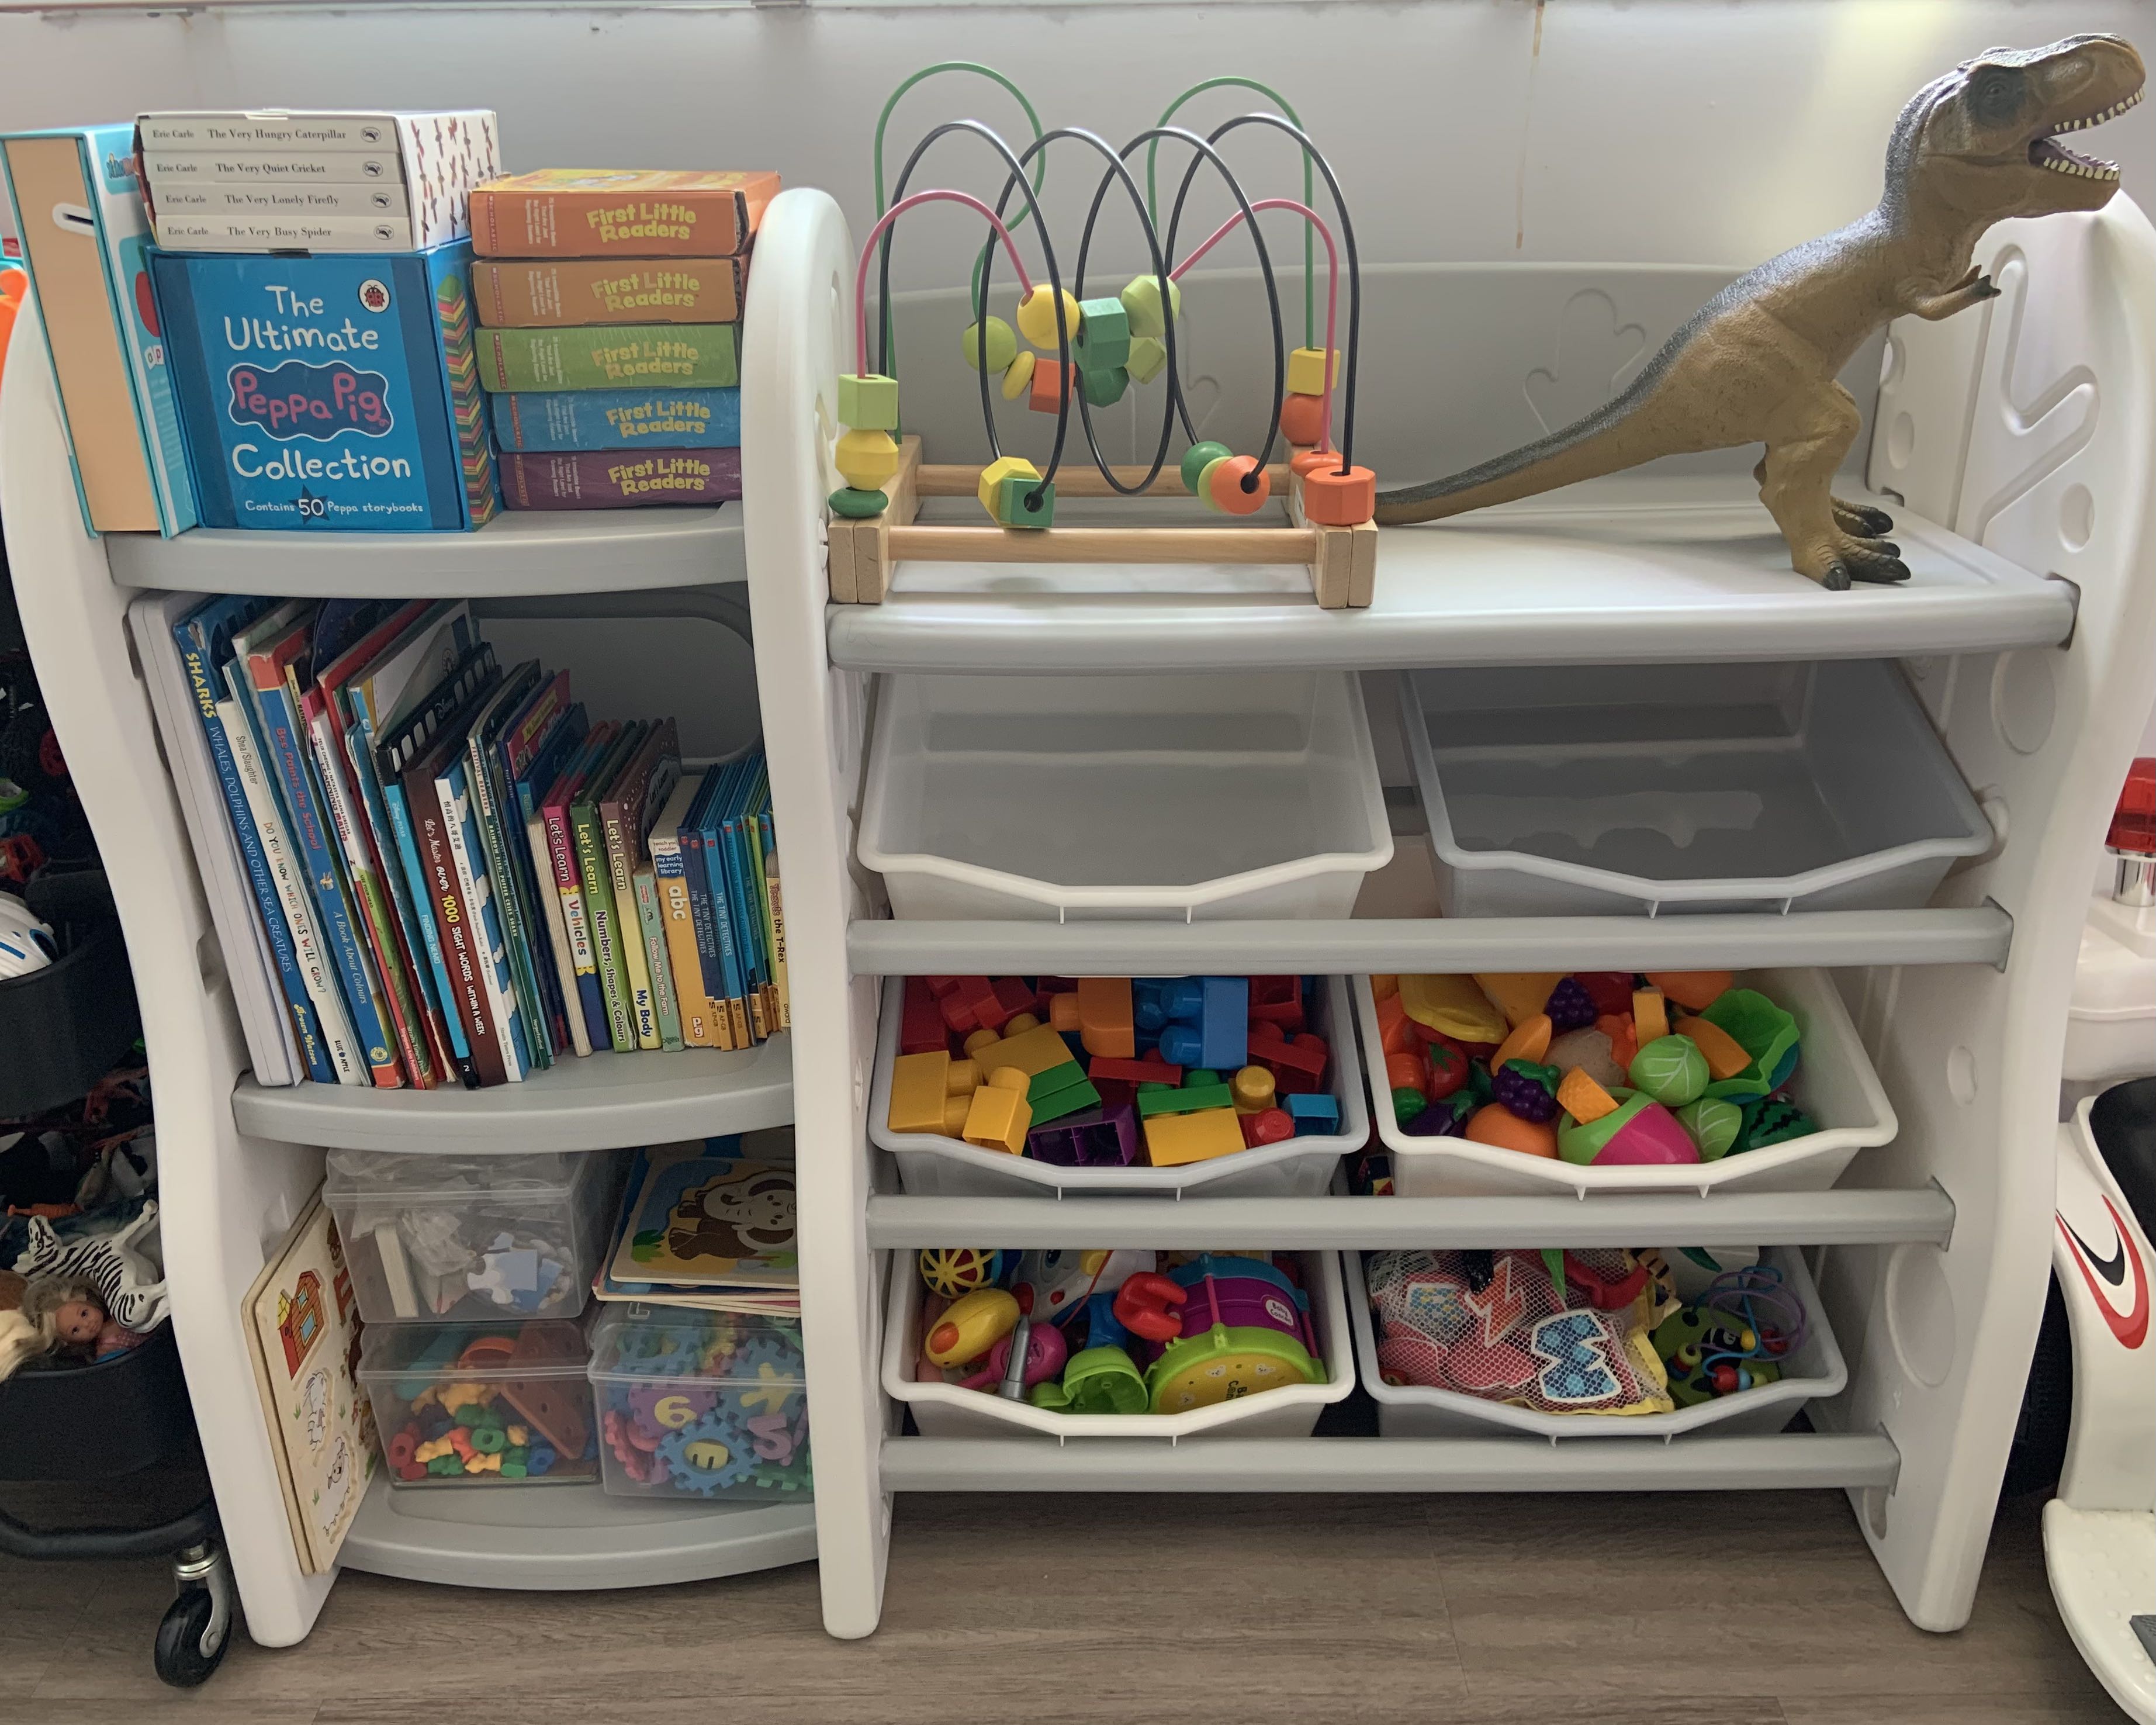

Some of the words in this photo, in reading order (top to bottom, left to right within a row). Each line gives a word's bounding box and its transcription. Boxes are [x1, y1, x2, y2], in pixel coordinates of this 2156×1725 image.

[153, 130, 170, 138] Eric
[173, 130, 194, 138] Carle
[207, 129, 226, 139] The
[229, 129, 252, 141] Very
[255, 129, 292, 141] Hungry
[295, 130, 346, 141] Caterpillar
[157, 164, 174, 172] Eric
[176, 164, 198, 172] Carle
[216, 164, 234, 172] The
[237, 164, 259, 175] Very
[263, 164, 288, 174] Quiet
[292, 164, 326, 172] Cricket
[166, 195, 182, 203] Eric
[185, 195, 206, 203] Carle
[224, 195, 243, 203] The
[245, 195, 268, 206] Very
[272, 195, 304, 206] Lonely
[307, 195, 339, 206] Firefly
[488, 199, 498, 252] SCHOLASTIC
[587, 204, 635, 227] First
[640, 203, 697, 224] Little
[168, 227, 184, 235] Eric
[187, 227, 208, 235] Carle
[227, 227, 245, 236] The
[249, 227, 270, 238] Very
[275, 227, 298, 238] Busy
[301, 227, 331, 238] Spider
[600, 220, 690, 243] Readers
[591, 273, 639, 298] First
[643, 271, 700, 291] Little
[264, 285, 324, 317] The
[493, 274, 505, 323] SCHOLASTIC
[605, 289, 694, 312] Readers
[224, 316, 379, 351] Ultimate
[495, 340, 507, 389] SCHOLASTIC
[591, 342, 639, 367] First
[643, 342, 699, 361] Little
[605, 358, 694, 380] Readers
[234, 370, 333, 429] Peppa
[332, 371, 389, 427] Pig
[607, 402, 653, 425] First
[657, 400, 711, 419] Little
[621, 416, 705, 438] Readers
[232, 443, 411, 480] Collection
[608, 459, 653, 484] First
[657, 458, 711, 476] Little
[621, 473, 706, 496] Readers
[245, 500, 295, 512] Contains
[299, 499, 324, 516] 50
[328, 501, 358, 514] Peppa
[363, 502, 424, 514] storybooks
[186, 652, 217, 718] SHARKS
[236, 735, 258, 784] Shea/Slaughter
[322, 751, 331, 772] CHEONG
[472, 746, 482, 776] FESTIVAL
[479, 780, 489, 810] READERS
[296, 791, 307, 809] the
[302, 813, 321, 851] School
[392, 801, 400, 821] Disney
[264, 822, 274, 834] DO
[424, 818, 437, 839] Let's
[549, 817, 565, 845] Let's
[578, 824, 594, 854] Let's
[607, 820, 622, 850] Let's
[210, 727, 231, 775] WHALES,
[225, 777, 250, 831] DOLPHINS
[242, 834, 258, 857] AND
[251, 860, 269, 897] OTHER
[262, 897, 275, 915] SEA
[269, 917, 292, 973] CREATURES
[269, 836, 282, 854] YOU
[429, 838, 441, 864] Master
[275, 858, 289, 880] KNOW
[555, 846, 570, 881] Learn
[584, 857, 598, 895] Learn
[612, 853, 627, 890] Learn
[436, 866, 450, 892] over
[488, 824, 499, 855] RAINBOW
[500, 875, 508, 897] PUFFER
[509, 918, 518, 937] SHARK
[285, 884, 298, 910] WHICH
[441, 894, 460, 924] 1000
[668, 886, 688, 920] abc
[716, 892, 724, 904] THE
[770, 884, 781, 916] Travis
[294, 913, 308, 935] ONES
[702, 907, 710, 921] TINY
[718, 906, 726, 920] TINY
[774, 918, 783, 934] the
[421, 914, 434, 945] FINDING
[430, 943, 440, 964] NEMO
[451, 926, 466, 950] SIGHT
[569, 900, 587, 956] Vehicles
[594, 910, 613, 966] Numbers,
[705, 922, 716, 957] DETECTIVES
[721, 921, 732, 956] DETECTIVES
[301, 938, 316, 962] WILL
[336, 921, 348, 943] Book
[344, 945, 358, 970] About
[352, 973, 368, 1004] Colours
[649, 936, 659, 963] Follow
[776, 936, 785, 963] T-Rex
[458, 951, 473, 982] WORDS
[654, 962, 662, 974] Me
[656, 974, 664, 983] to
[310, 967, 326, 993] GROW?
[606, 967, 618, 999] Shapes
[657, 982, 666, 996] the
[466, 985, 479, 1012] WITHIN
[612, 999, 621, 1010] &
[636, 990, 647, 1007] My
[660, 995, 669, 1016] Farm
[293, 1004, 309, 1033] Brown
[304, 1035, 317, 1066] Watson
[474, 1017, 486, 1036] WEEK
[613, 1009, 626, 1043] Colours
[640, 1010, 653, 1037] Body
[334, 1040, 343, 1052] BLUE
